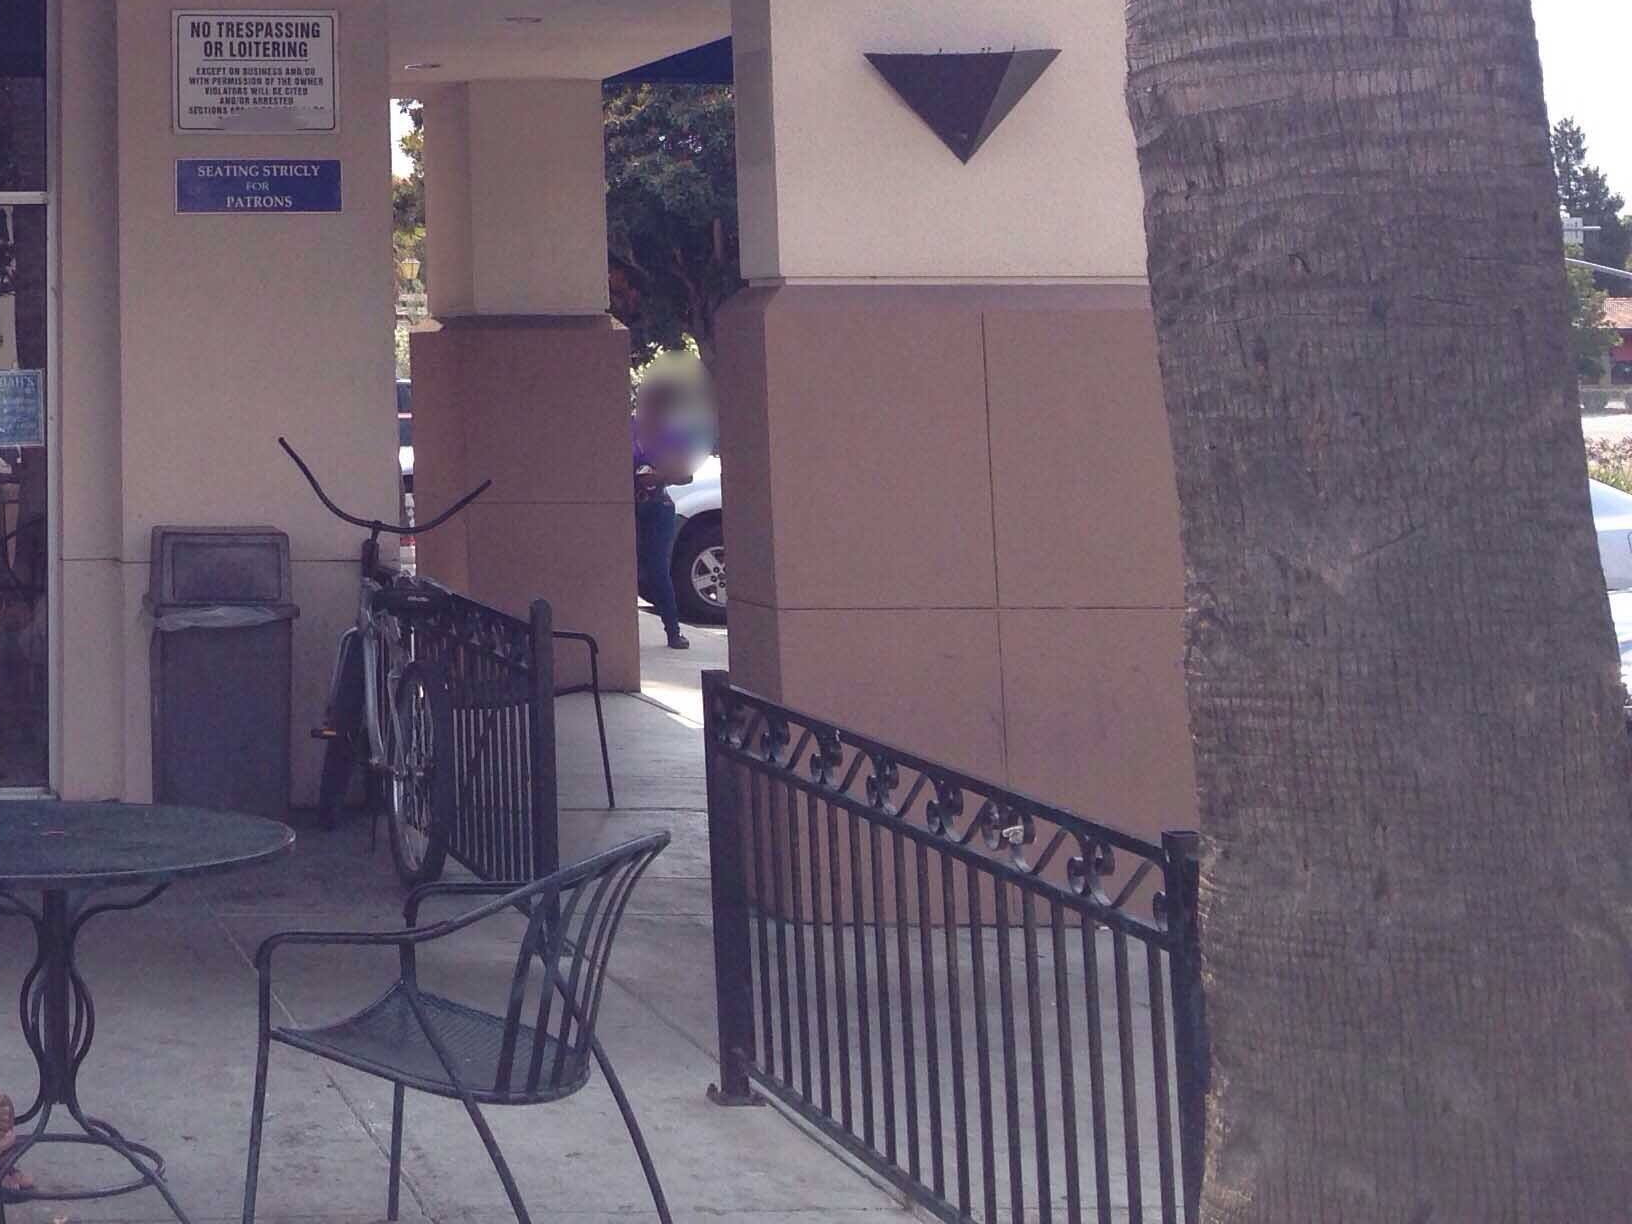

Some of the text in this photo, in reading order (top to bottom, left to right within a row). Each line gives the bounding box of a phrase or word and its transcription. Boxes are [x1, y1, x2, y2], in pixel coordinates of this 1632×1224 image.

[190, 22, 321, 39] NO TRESPASSING
[204, 42, 308, 58] OR LOITERING
[196, 67, 226, 75] EXCEPT
[243, 67, 282, 75] BUSINESS
[189, 77, 324, 86] WITH PERMISSION OF THE OWNER
[205, 87, 308, 96] VIOLATORS WILL BE CITED
[219, 97, 294, 105] AND/OR ARRESTED
[188, 106, 227, 114] SECTIONS
[197, 165, 320, 177] SEATING STRICLY
[245, 182, 270, 191] FOR
[226, 196, 293, 208] PATRONS
